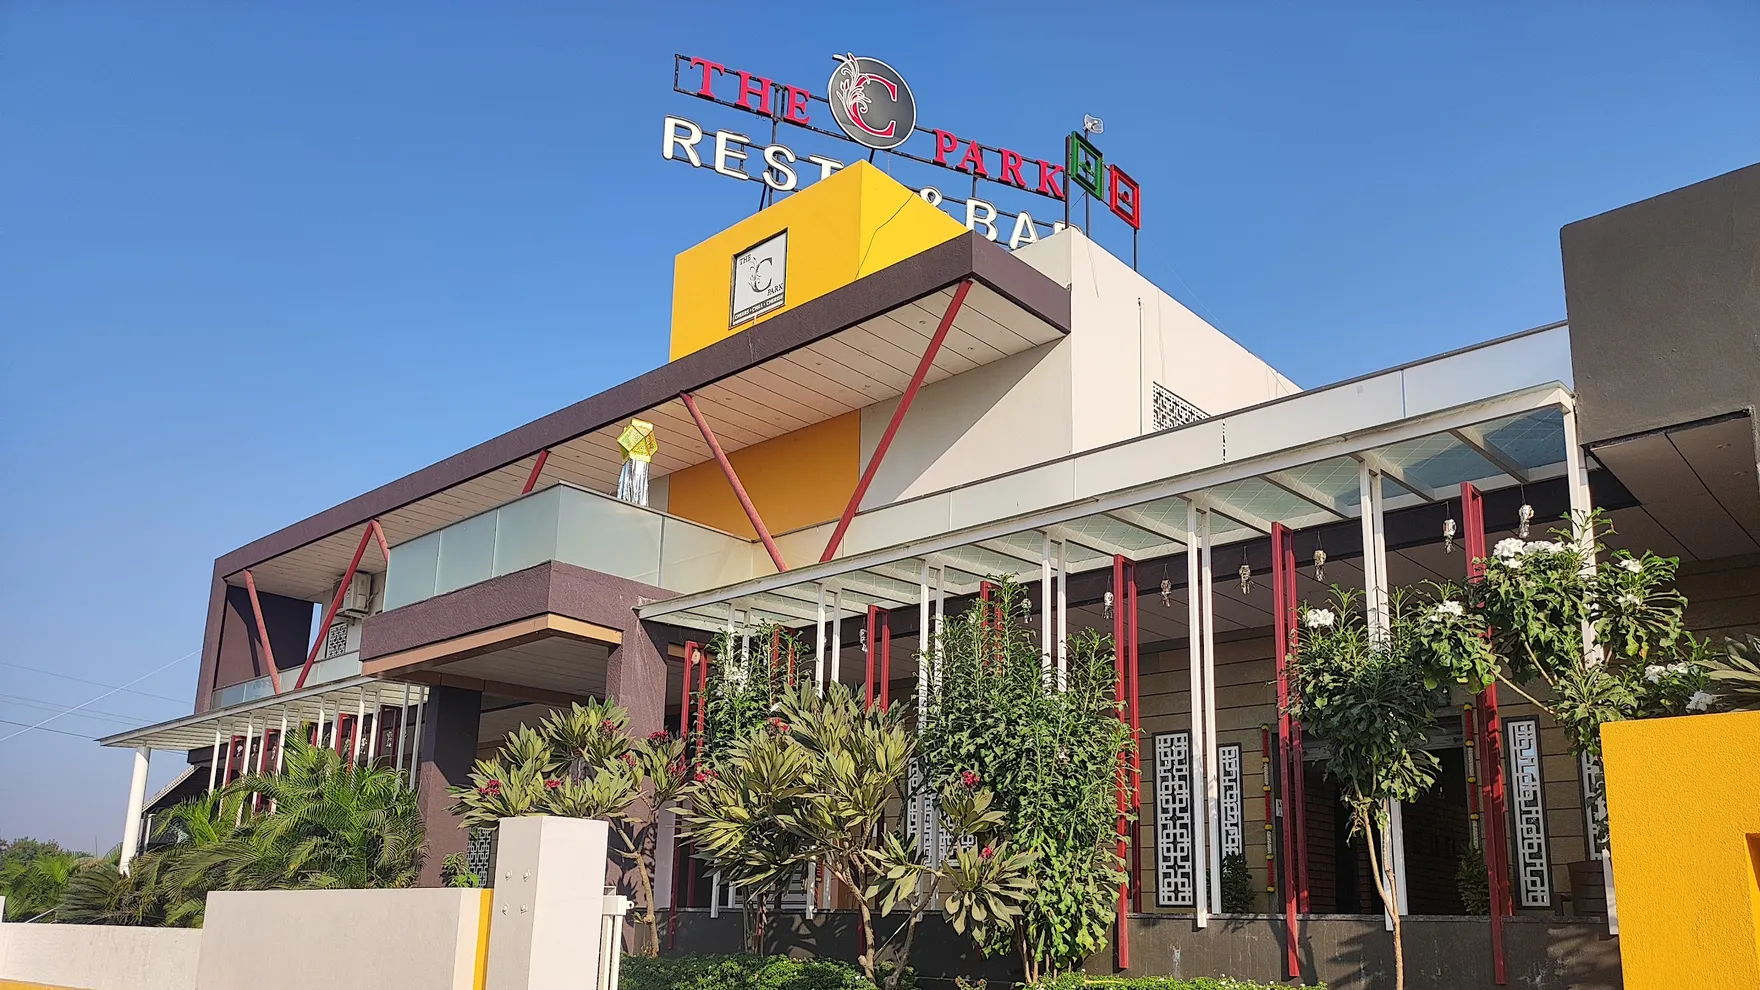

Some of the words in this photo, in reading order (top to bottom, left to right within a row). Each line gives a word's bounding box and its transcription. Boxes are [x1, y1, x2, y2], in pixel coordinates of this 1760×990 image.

[690, 56, 810, 125] THE
[848, 73, 897, 138] C
[933, 128, 1064, 199] PARK
[739, 254, 752, 266] THE
[751, 256, 773, 293] C
[766, 283, 784, 297] PARK
